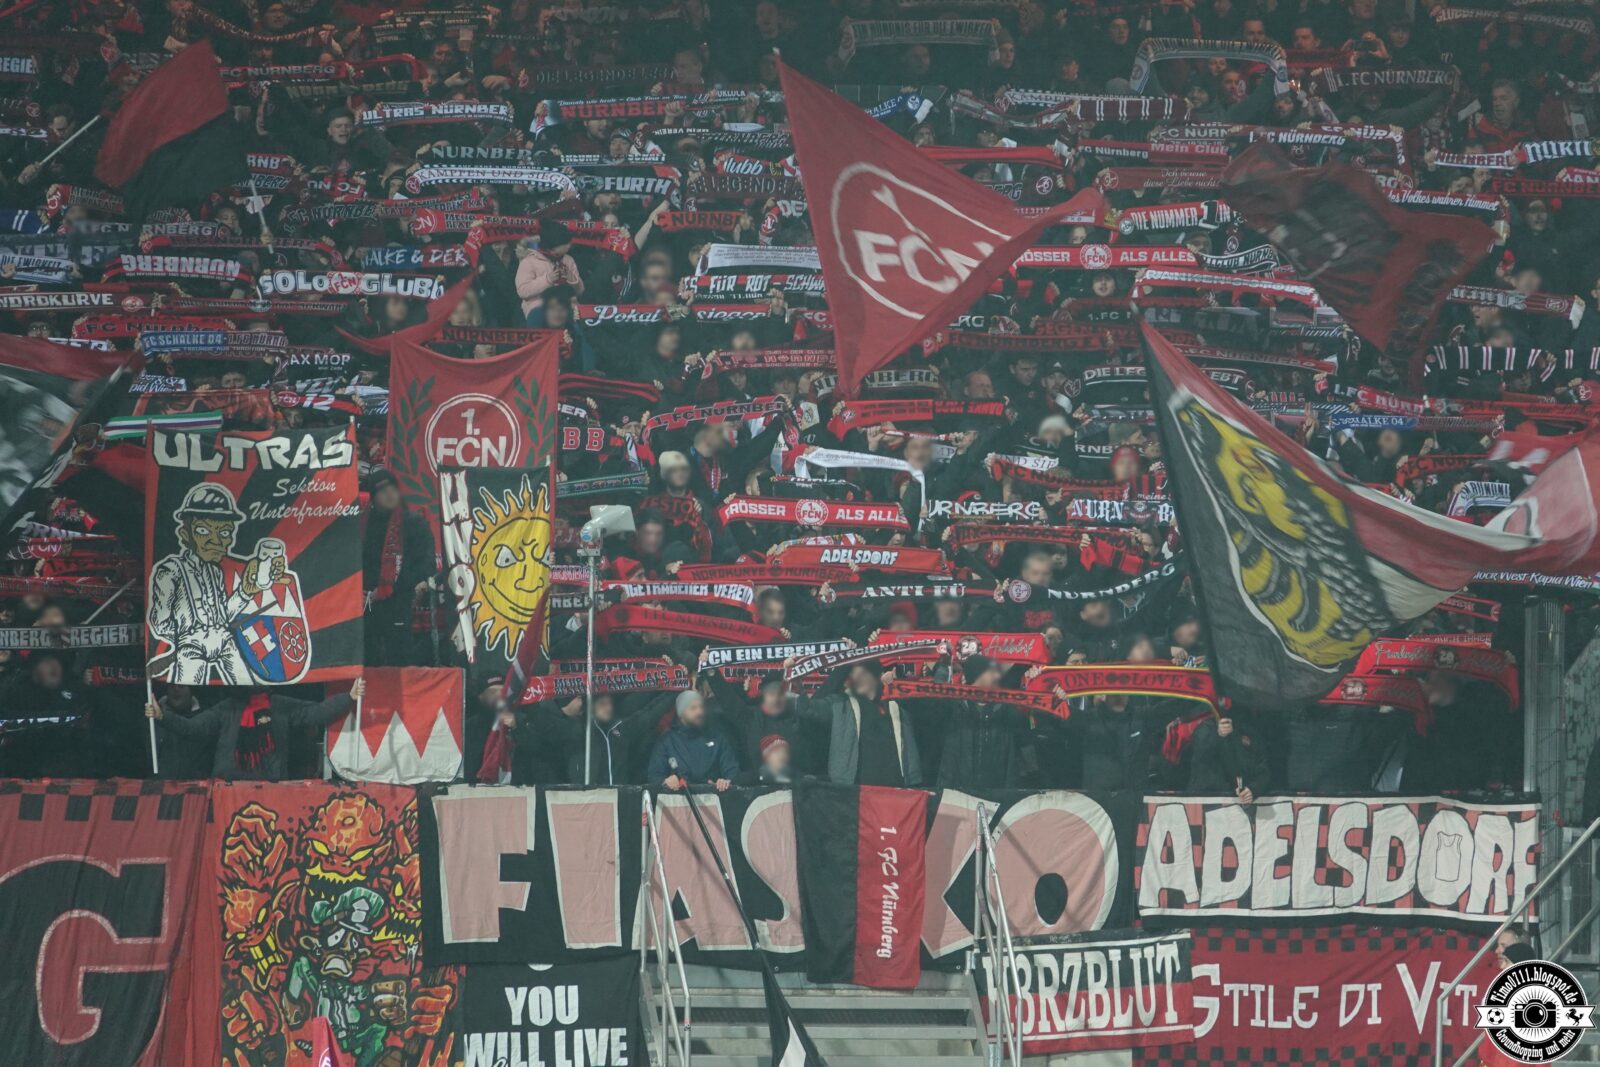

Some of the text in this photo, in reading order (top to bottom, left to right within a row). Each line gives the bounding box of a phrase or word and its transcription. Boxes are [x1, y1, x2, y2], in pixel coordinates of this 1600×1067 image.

[1352, 72, 1370, 85] FC
[1150, 206, 1198, 230] NUMMER
[1120, 251, 1147, 262] ALS
[1152, 251, 1195, 262] ALLES
[709, 275, 736, 292] FÜR
[745, 275, 771, 292] ROT
[585, 304, 663, 327] Pokal
[461, 408, 480, 436] 1.
[153, 432, 353, 472] ULTRAS
[437, 435, 507, 467] FCN
[273, 476, 336, 497] Sektion
[248, 498, 360, 520] Unterfranken
[836, 508, 864, 521] ALS
[820, 549, 899, 566] ADELSDORF
[862, 586, 924, 597] ANTI
[735, 648, 763, 662] EIN
[766, 644, 816, 660] LEBEN
[1065, 671, 1182, 689] ONE LOVE
[1138, 801, 1541, 914] ADELSDORF
[876, 880, 899, 960] Nürnberg
[504, 985, 579, 1027] YOU
[1396, 961, 1478, 1036] VIT
[464, 1027, 629, 1067] WILL LIVE
